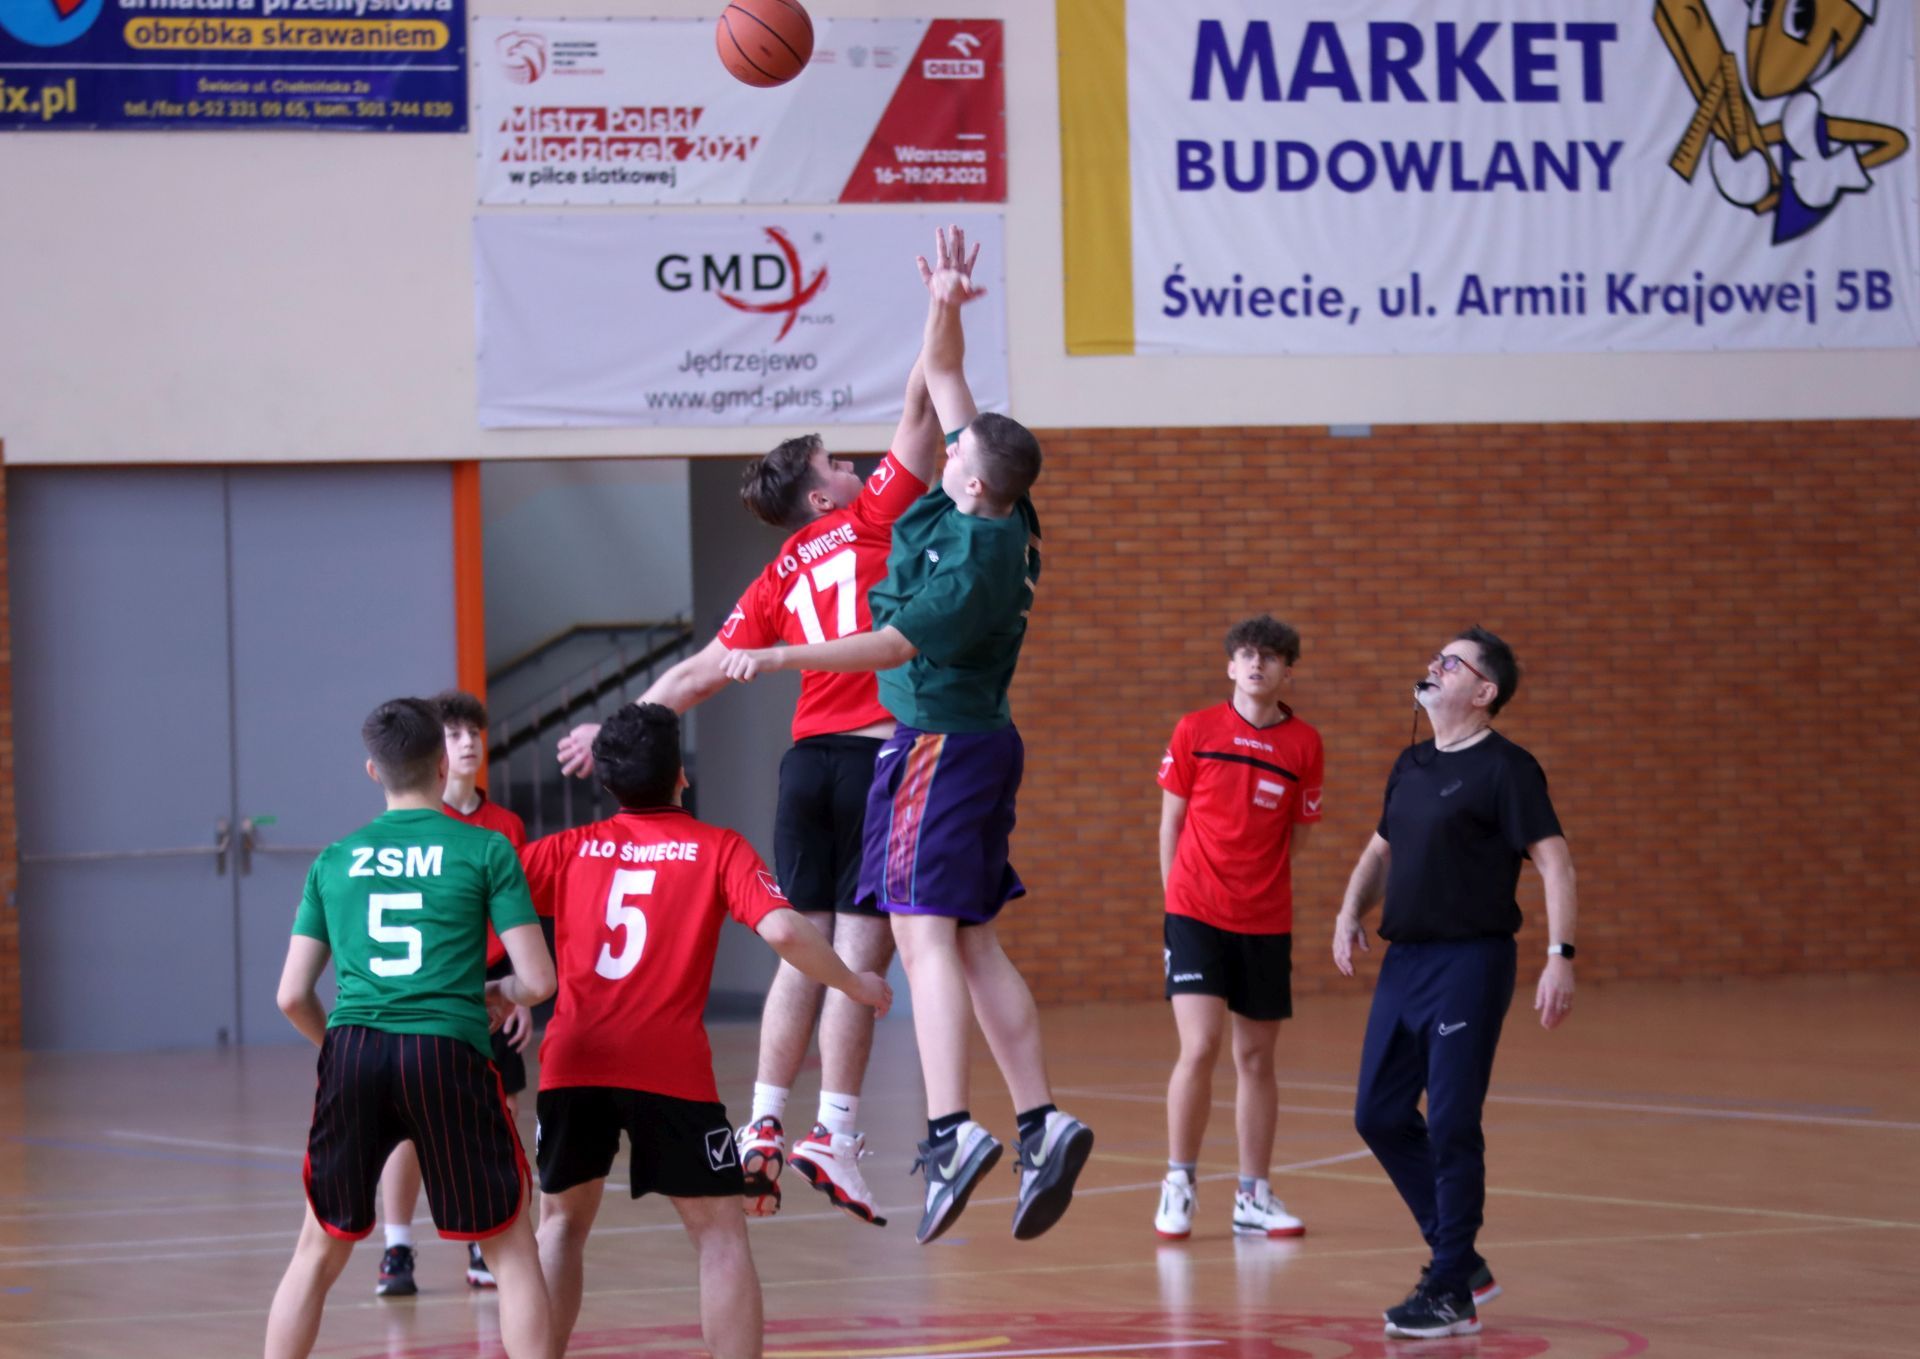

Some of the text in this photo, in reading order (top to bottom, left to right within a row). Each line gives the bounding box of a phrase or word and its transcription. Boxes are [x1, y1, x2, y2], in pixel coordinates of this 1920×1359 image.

[135, 20, 437, 46] obróbka skrawaniem
[928, 62, 979, 75] ORLEN
[1190, 19, 1617, 103] MARKET
[0, 77, 76, 121] ix.pl
[503, 107, 695, 132] Mistrz Polski
[683, 136, 752, 161] 2021
[894, 146, 986, 162] Warszawa
[508, 166, 677, 188] w piłce siatkowej
[1176, 139, 1625, 193] BUDOWLANY
[656, 254, 786, 291] GMD
[1162, 263, 1894, 326] Świecie, ul. Armii Krajowej 5B
[678, 349, 818, 377] Jędrzejewo
[645, 384, 853, 414] www.gmd-plus.pl
[797, 523, 858, 564] ŚWIECIE
[783, 548, 858, 645] 17
[348, 845, 443, 877] ZSM
[589, 840, 616, 858] LO
[620, 841, 698, 863] ŚWIECIE
[368, 893, 423, 977] 5
[595, 869, 656, 980] 5
